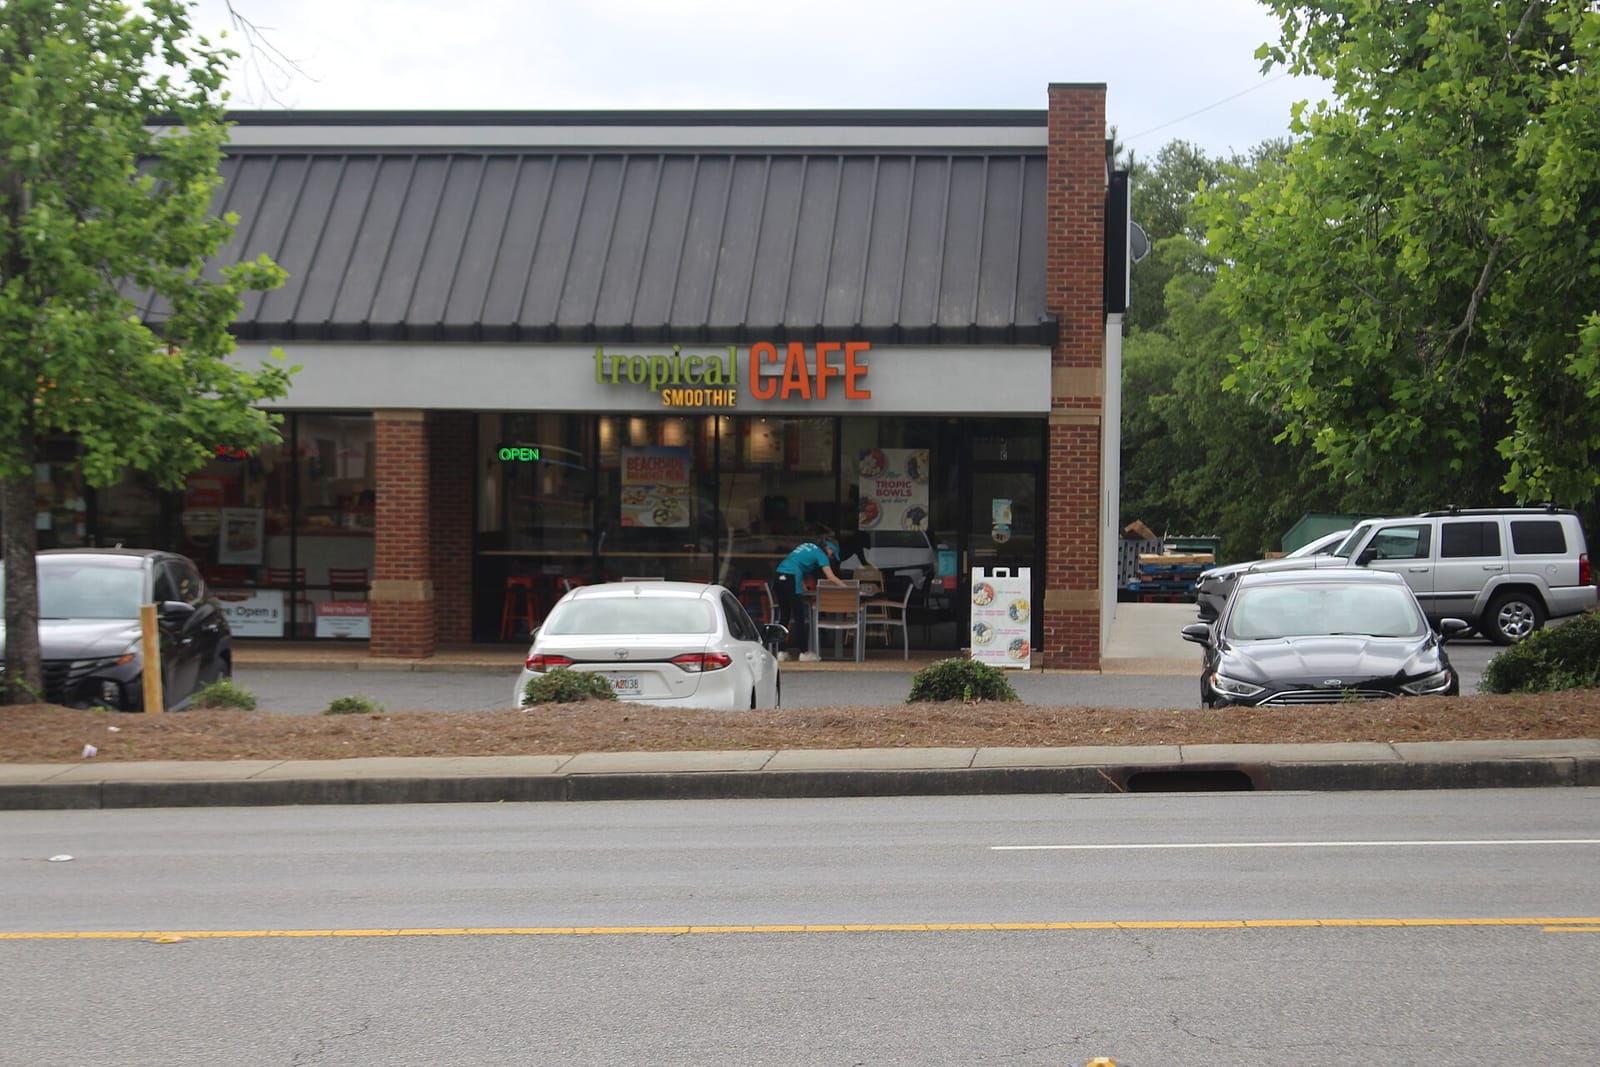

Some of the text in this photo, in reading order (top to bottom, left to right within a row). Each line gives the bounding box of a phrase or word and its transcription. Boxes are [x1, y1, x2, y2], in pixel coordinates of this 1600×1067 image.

[593, 341, 872, 400] tropical CAFE
[661, 388, 737, 407] SMOOTHIE
[498, 447, 539, 461] OPEN
[626, 456, 685, 470] BEACHSIDE
[875, 480, 912, 489] TROPIC
[875, 489, 912, 497] BOWLS
[236, 606, 269, 618] Open
